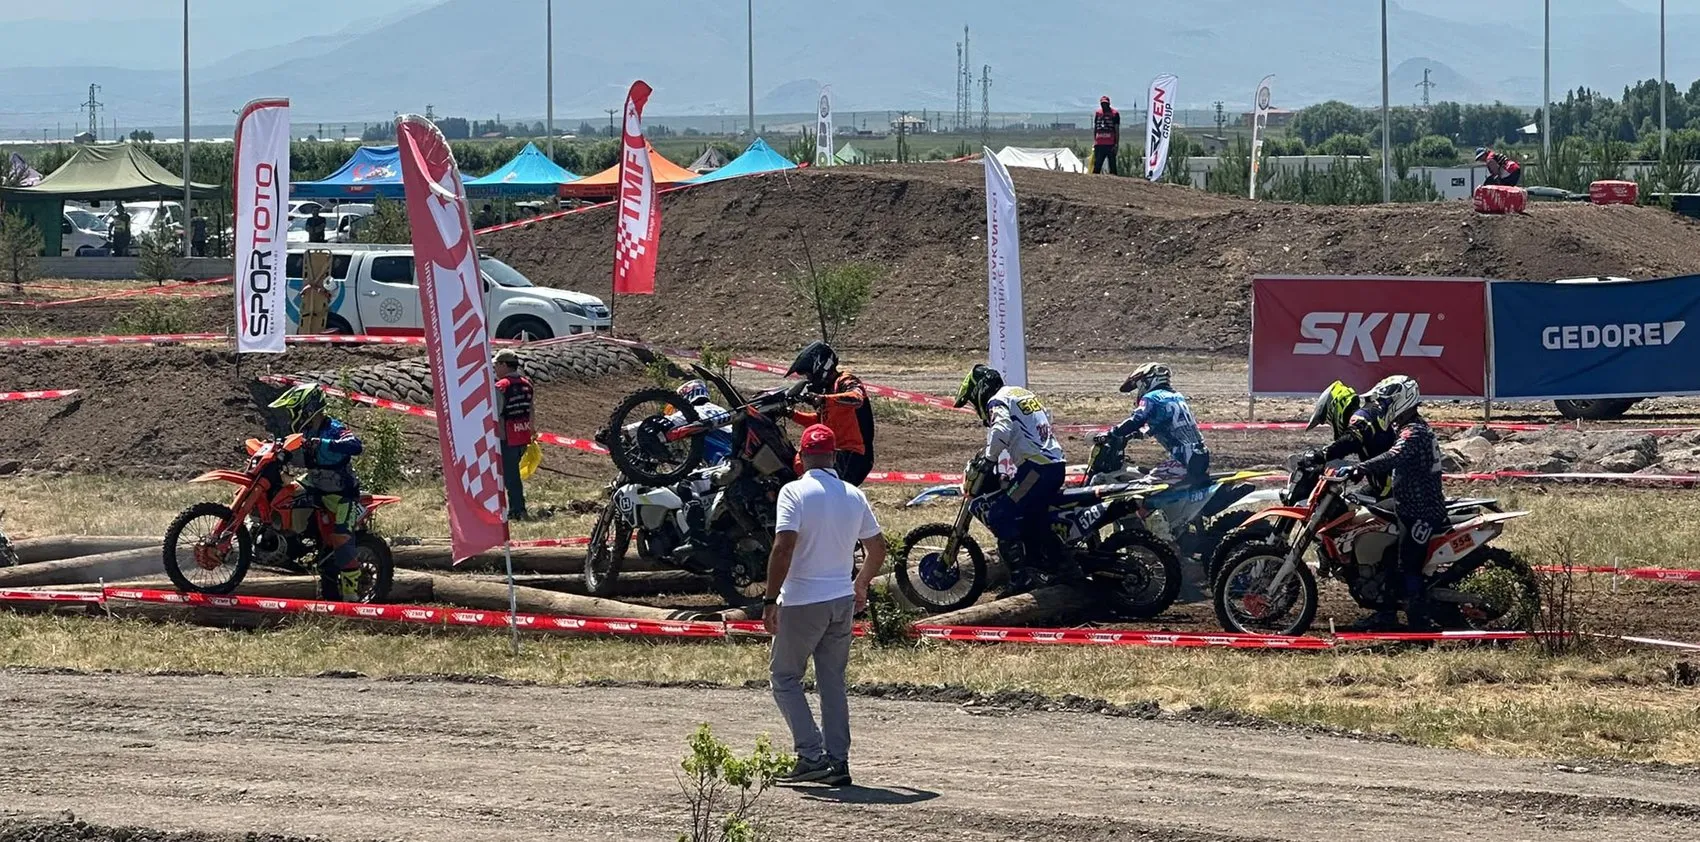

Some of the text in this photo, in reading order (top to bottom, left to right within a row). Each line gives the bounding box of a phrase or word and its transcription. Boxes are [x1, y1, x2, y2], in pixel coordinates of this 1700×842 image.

[1162, 103, 1173, 139] GROUP
[621, 154, 644, 222] TMF
[1293, 312, 1444, 362] SKIL
[1542, 322, 1663, 349] GEDORE
[1079, 505, 1101, 529] 528
